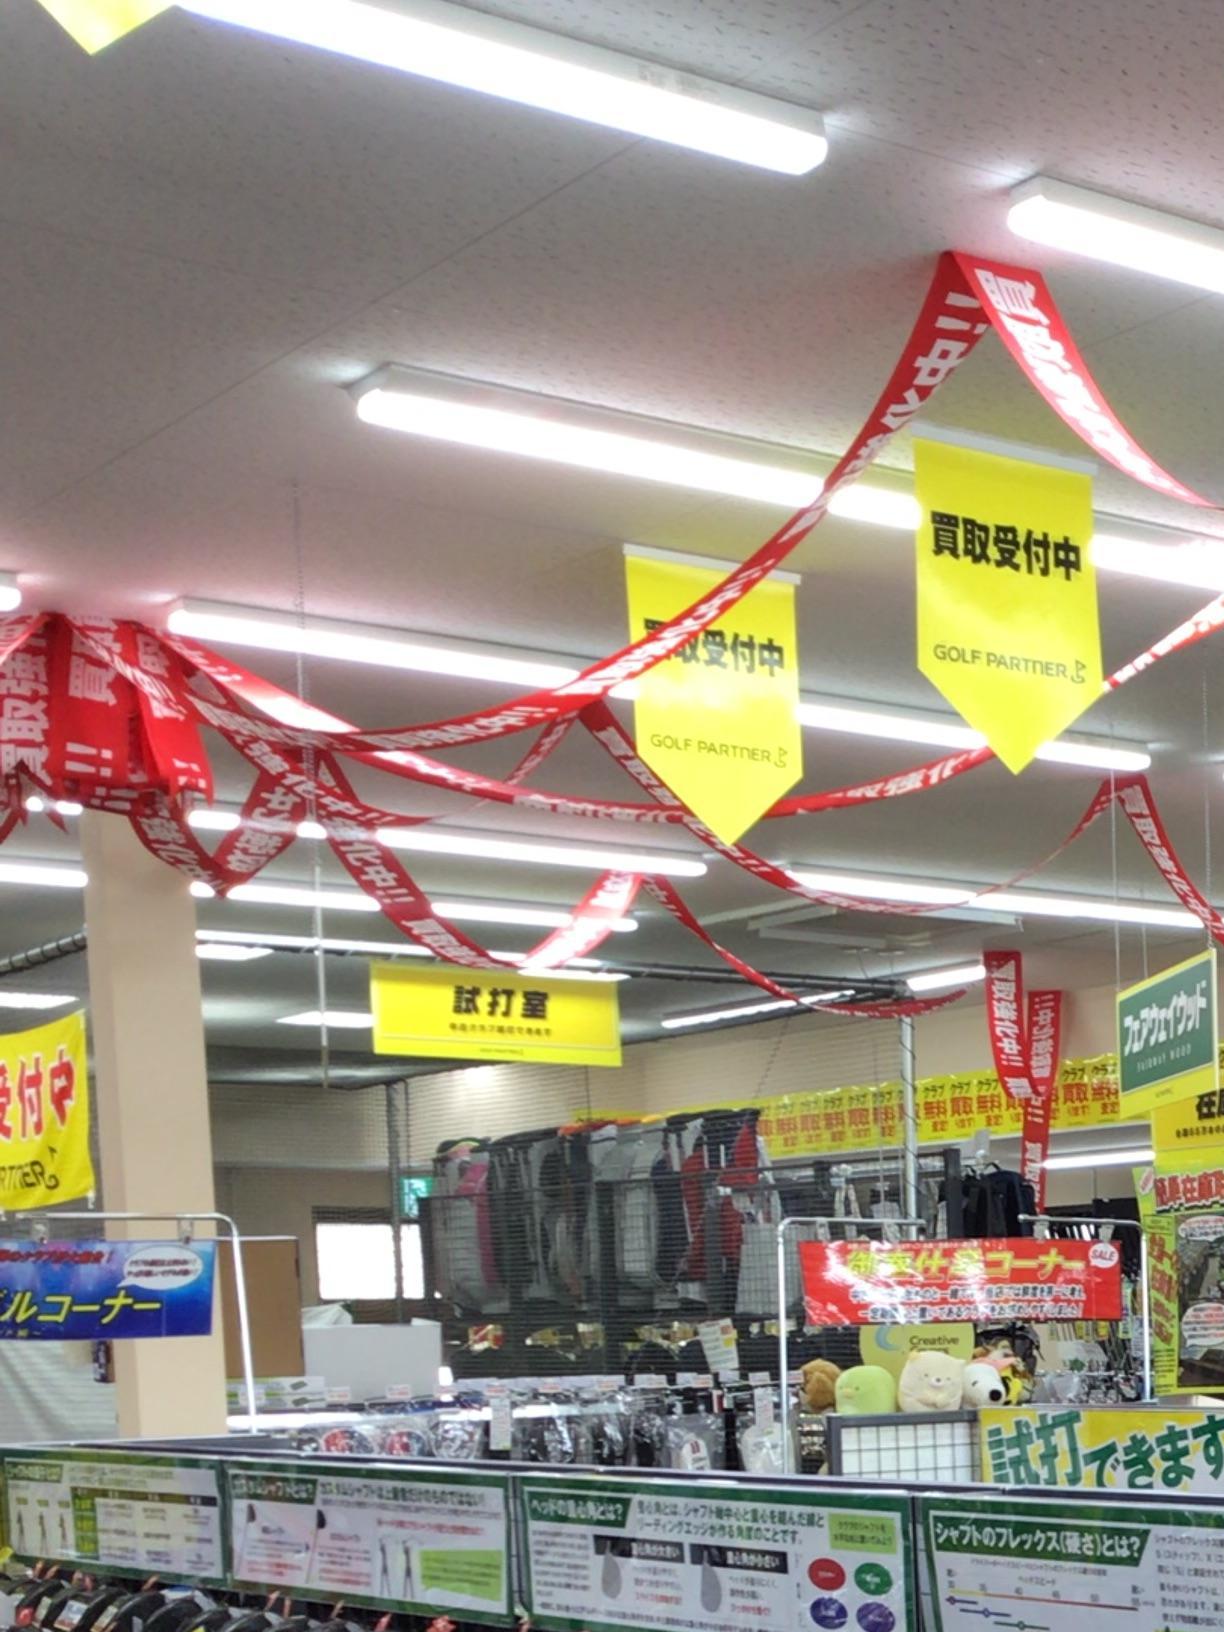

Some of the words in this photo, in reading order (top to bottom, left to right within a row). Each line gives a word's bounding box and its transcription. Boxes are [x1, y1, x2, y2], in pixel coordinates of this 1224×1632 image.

[930, 512, 1080, 580] 買取受付中
[934, 644, 980, 665] GOLF
[987, 652, 1067, 678] PARTNER
[651, 734, 692, 754] GOLF
[698, 740, 771, 763] PARTNER
[453, 985, 548, 1020] 試打室
[1124, 980, 1206, 1056] フェアウェイウッド
[0, 1289, 160, 1324] ルコーナー
[909, 1335, 959, 1346] Creative
